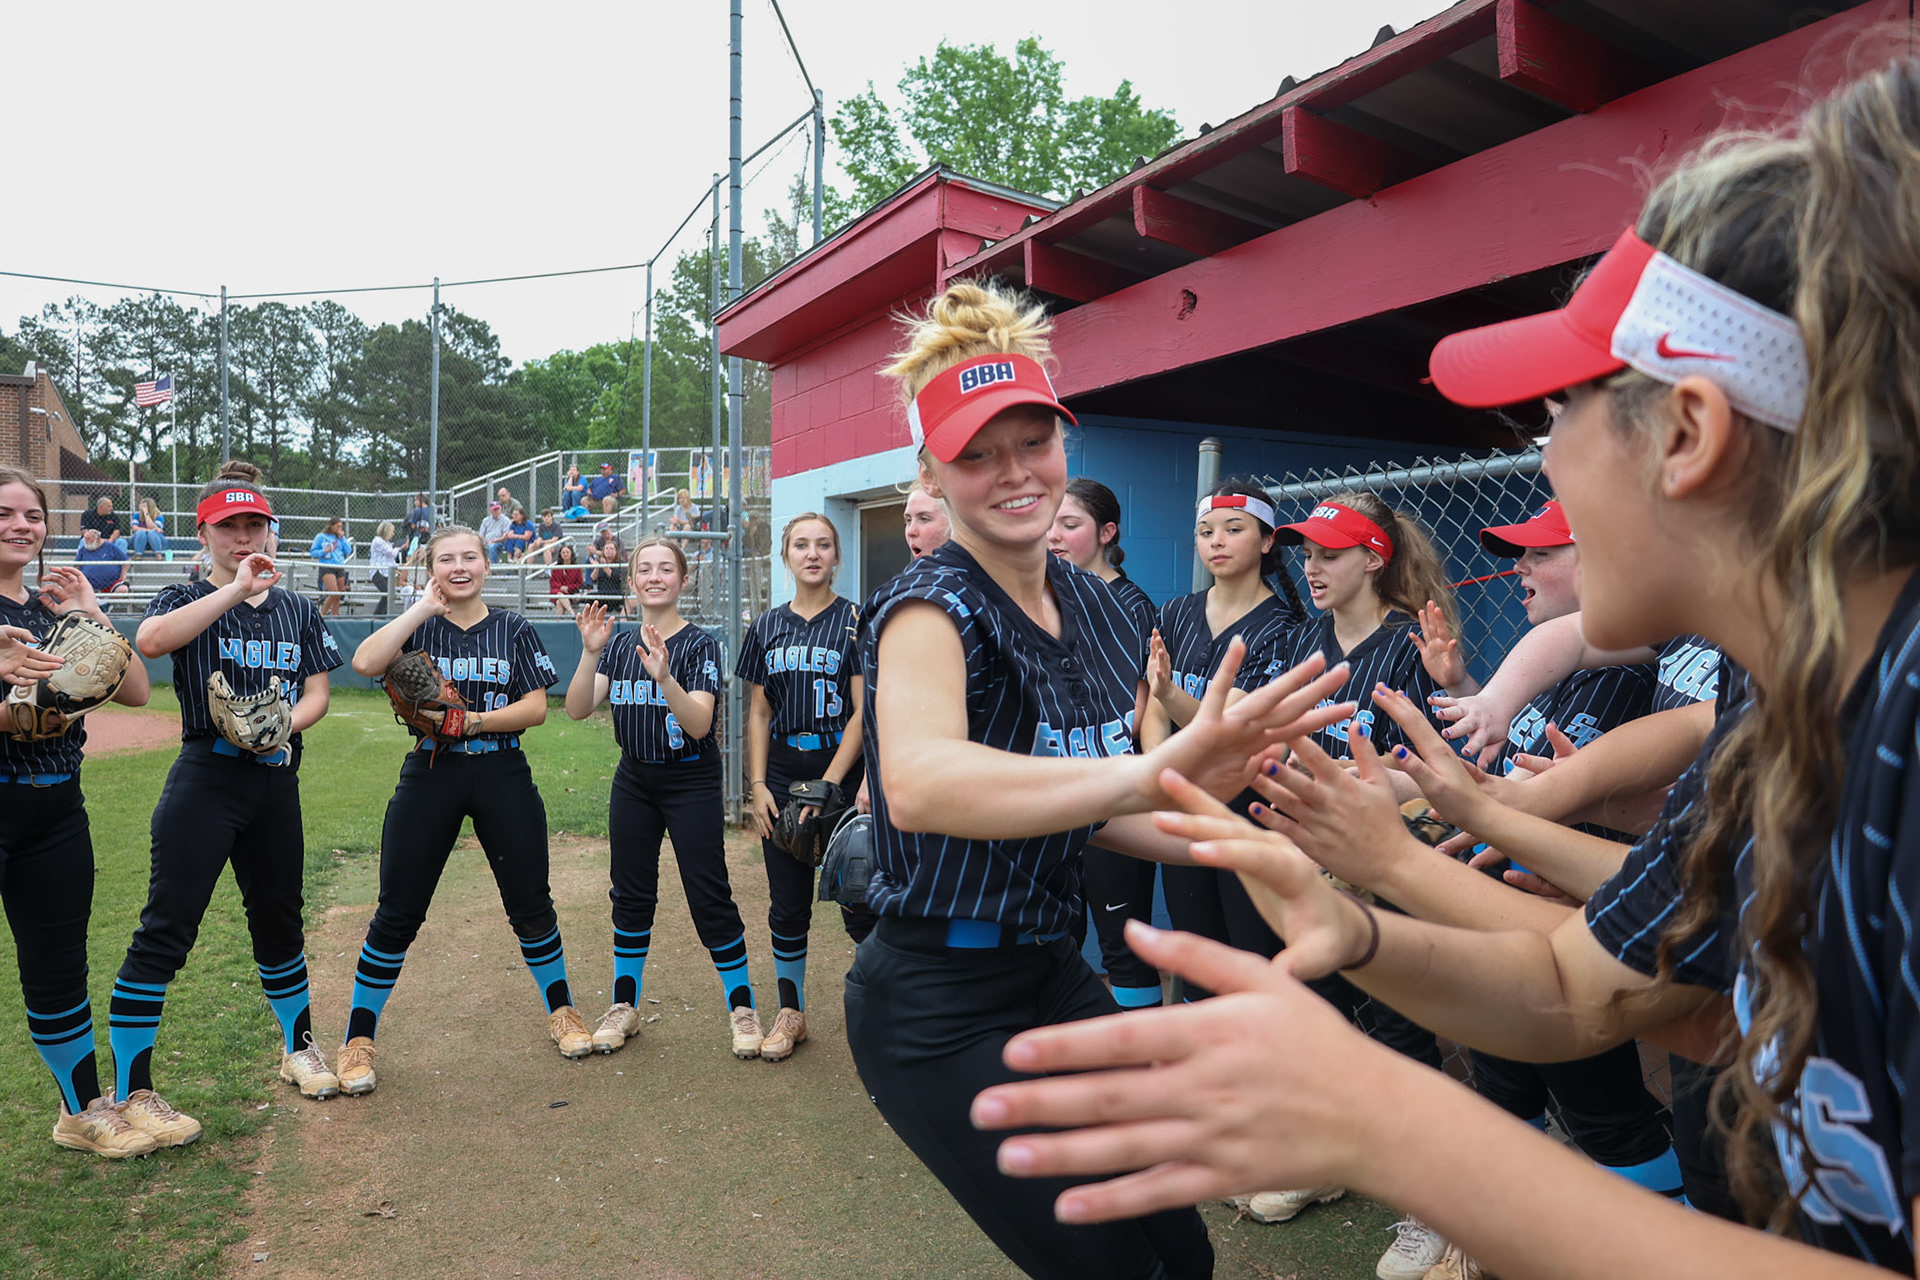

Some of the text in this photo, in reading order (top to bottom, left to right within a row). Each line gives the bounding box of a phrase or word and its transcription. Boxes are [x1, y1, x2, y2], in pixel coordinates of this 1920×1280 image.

[959, 361, 1016, 395] SBA
[225, 491, 255, 504] SBA
[430, 655, 511, 685] AGLES
[610, 680, 668, 706] EAGLE
[813, 678, 843, 718] 13
[665, 712, 685, 750] 6
